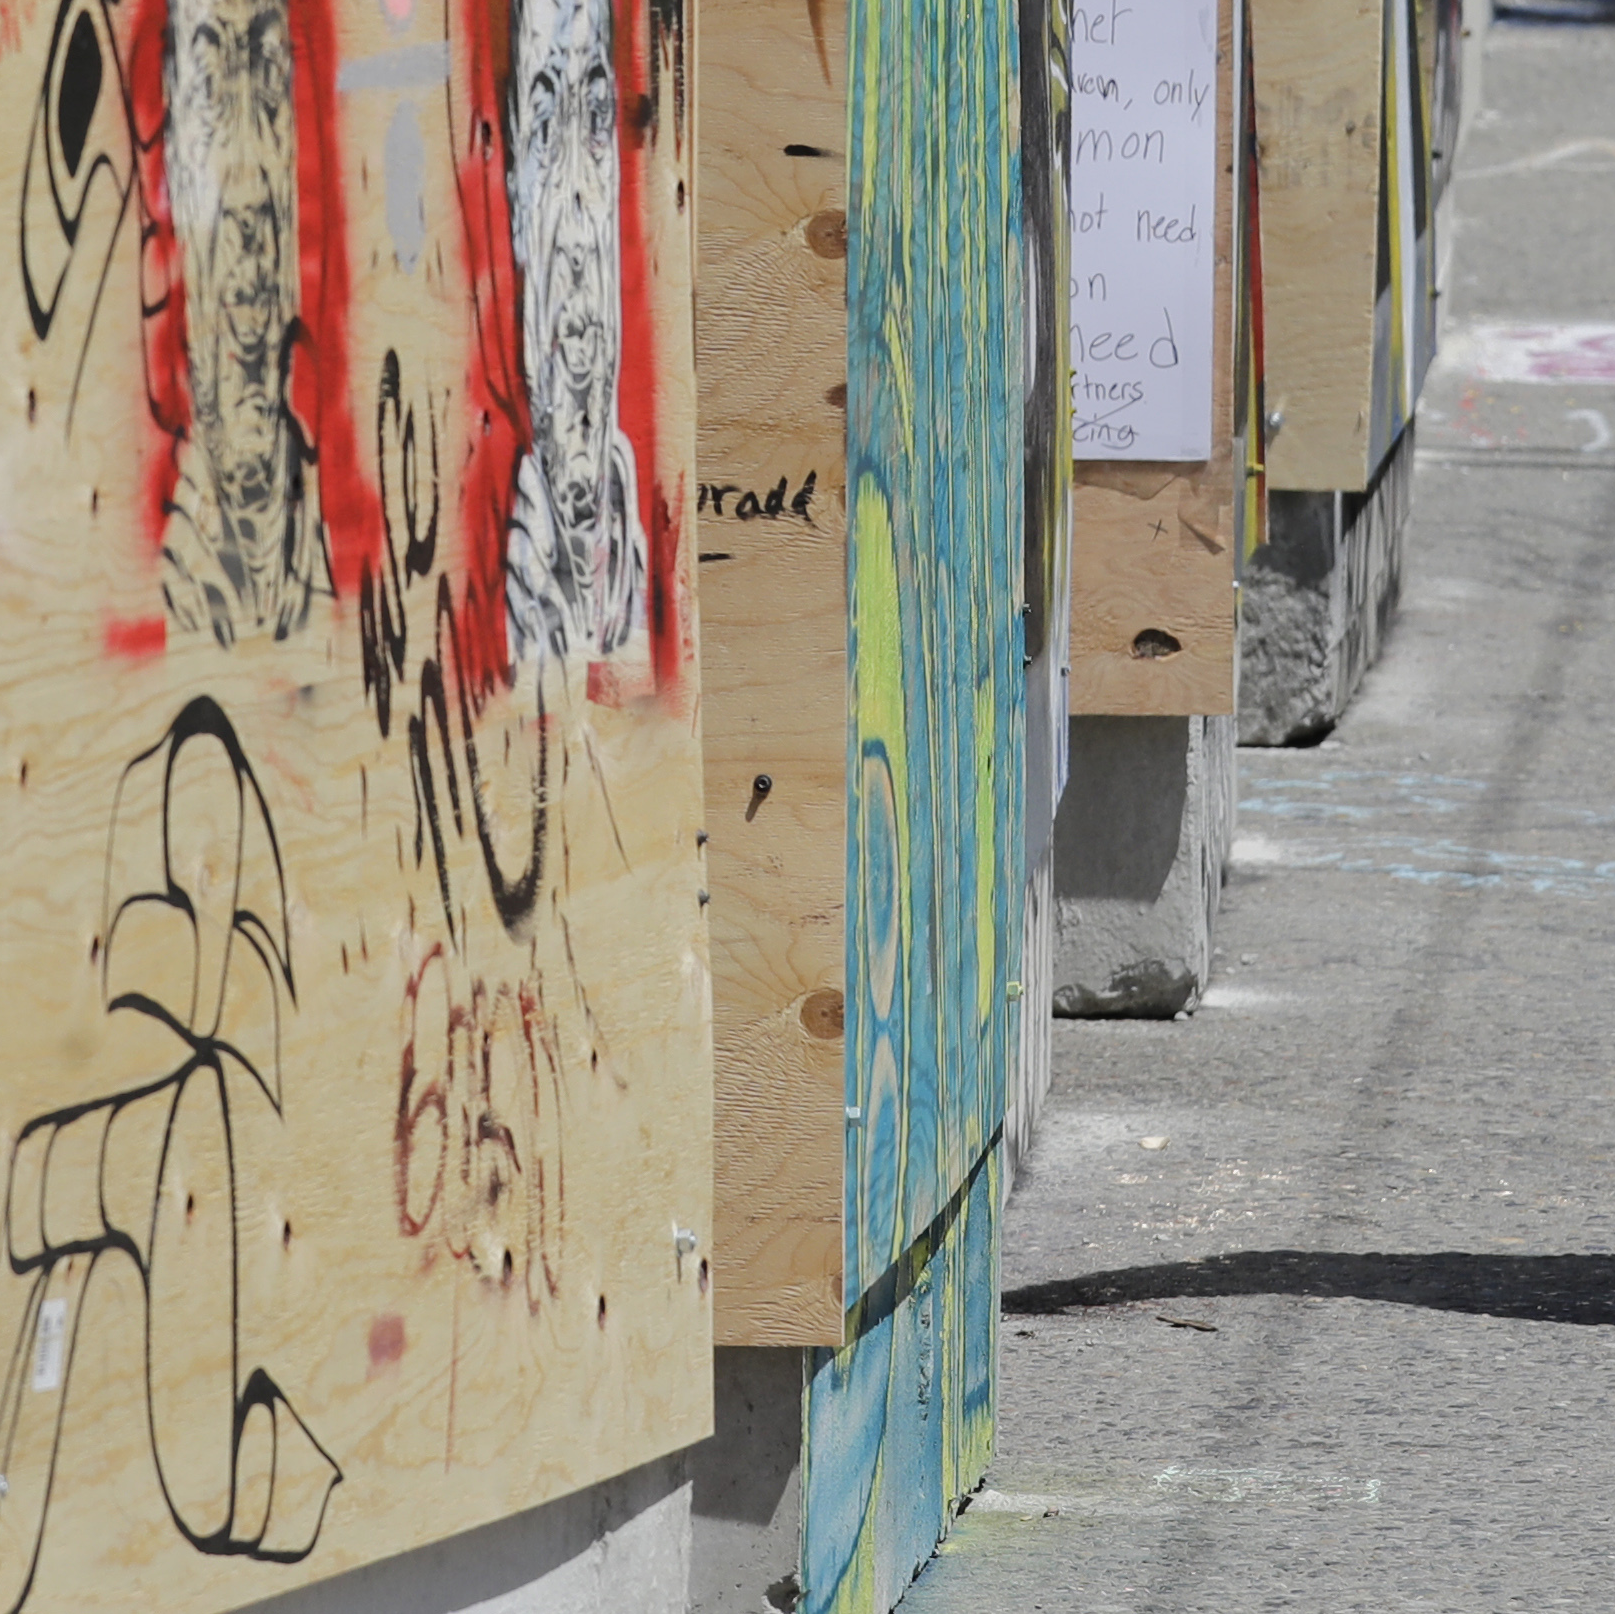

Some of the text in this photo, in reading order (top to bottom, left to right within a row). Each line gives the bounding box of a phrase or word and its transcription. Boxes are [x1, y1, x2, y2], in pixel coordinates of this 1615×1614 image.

[1153, 68, 1211, 123] only
[1076, 128, 1166, 165] mon
[1136, 203, 1198, 243] need
